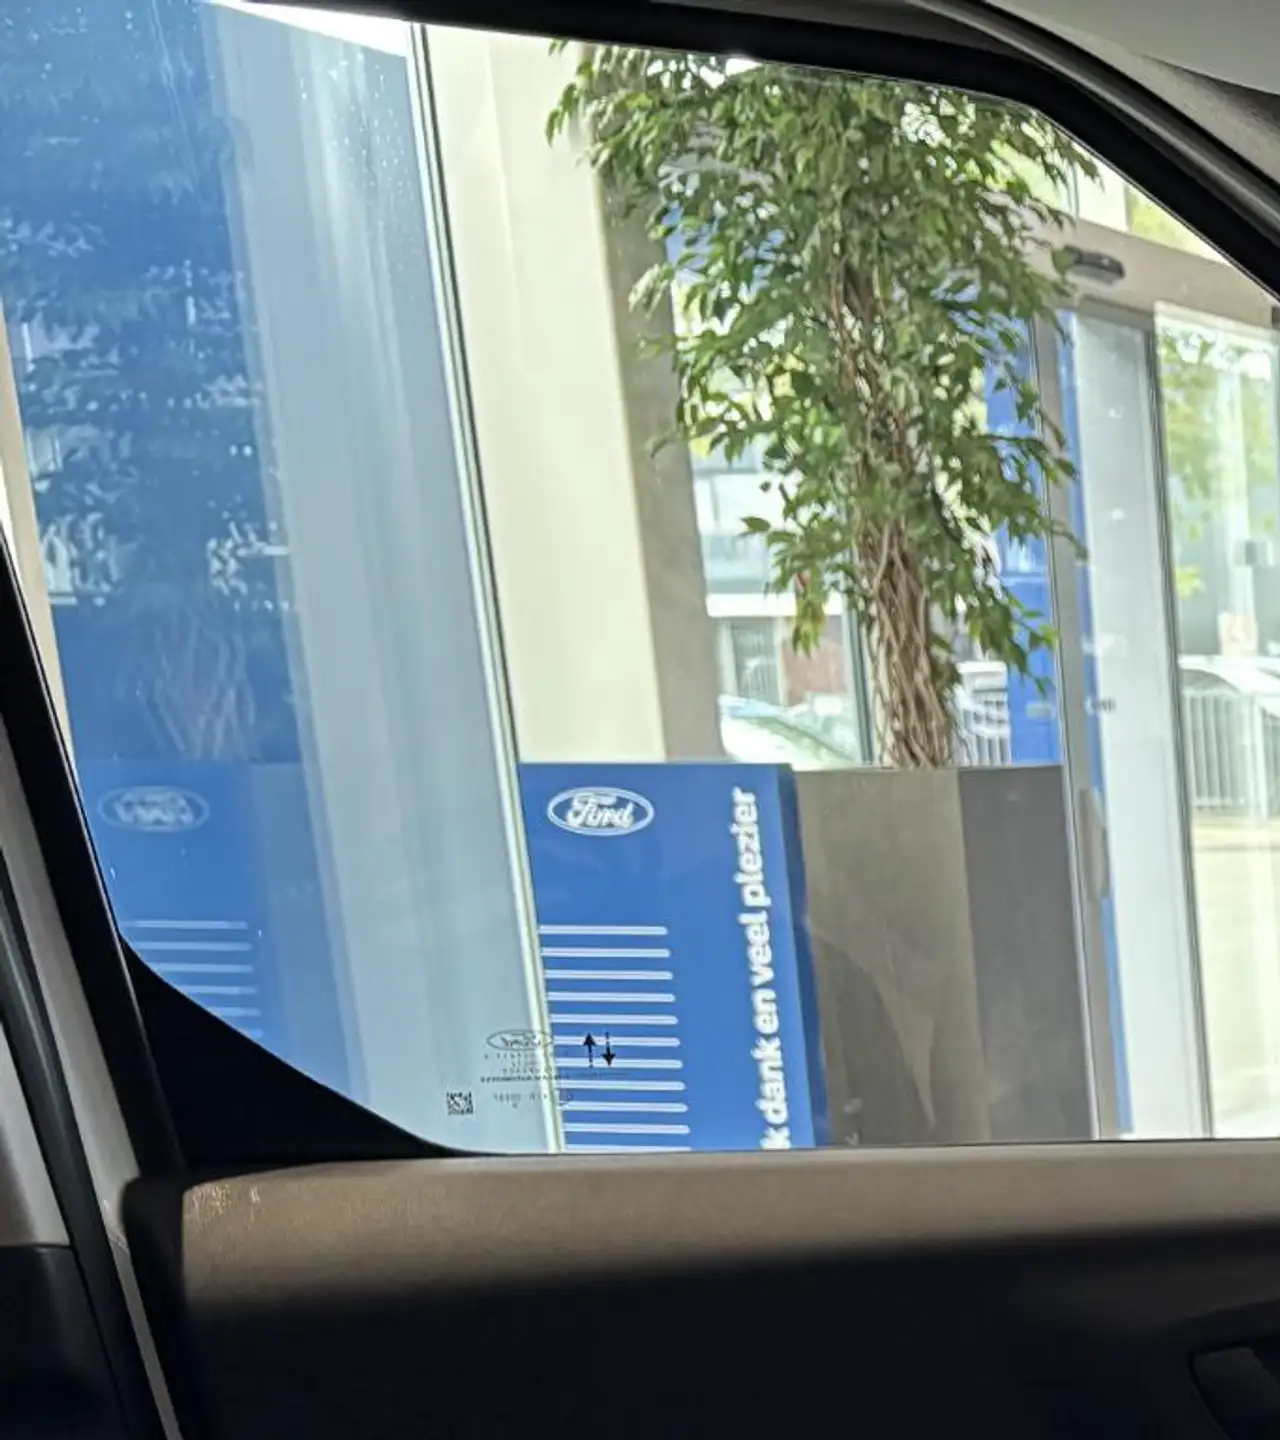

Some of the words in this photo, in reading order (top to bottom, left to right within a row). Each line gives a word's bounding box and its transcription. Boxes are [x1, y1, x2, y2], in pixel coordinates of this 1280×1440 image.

[564, 793, 634, 830] Ford
[729, 786, 772, 909] plezier
[738, 911, 776, 988] veel
[751, 989, 781, 1036] en
[751, 1036, 791, 1126] dank
